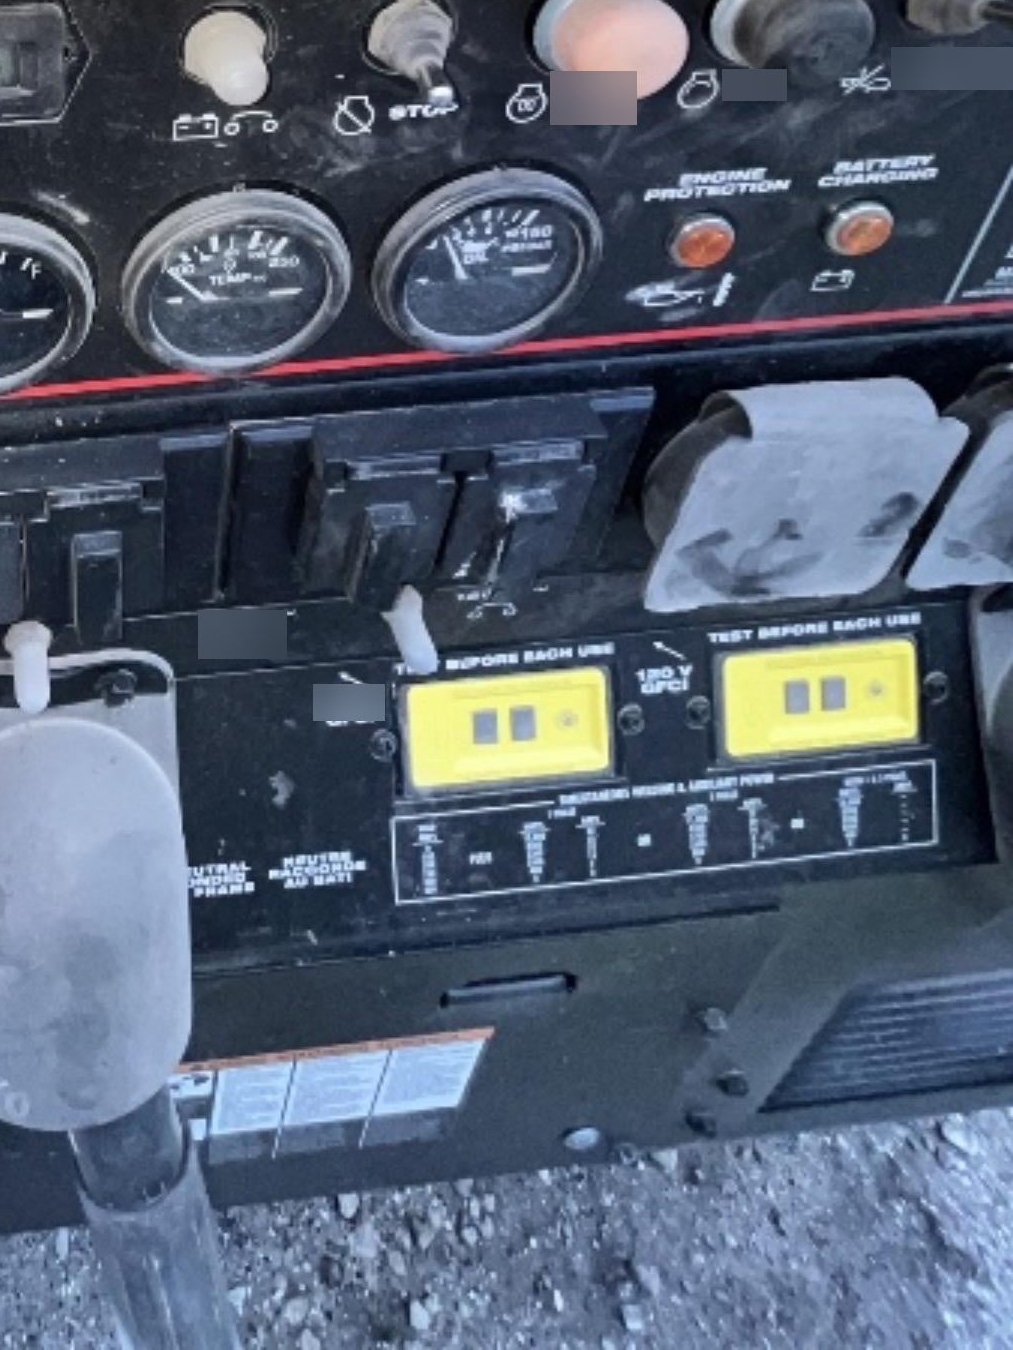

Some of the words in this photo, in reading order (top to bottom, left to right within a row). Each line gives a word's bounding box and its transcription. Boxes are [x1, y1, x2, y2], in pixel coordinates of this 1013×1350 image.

[833, 153, 936, 174] BATTERY
[679, 167, 768, 186] ENGINE
[818, 167, 939, 188] CHARGING
[644, 179, 792, 201] PROTECTION
[706, 628, 754, 644] TEST
[757, 620, 829, 640] BEFORE
[833, 616, 882, 632] EACH
[885, 611, 922, 627] USE
[445, 651, 520, 671] BEFORE
[523, 646, 574, 664] EACH
[578, 641, 616, 657] USE
[679, 664, 693, 677] V
